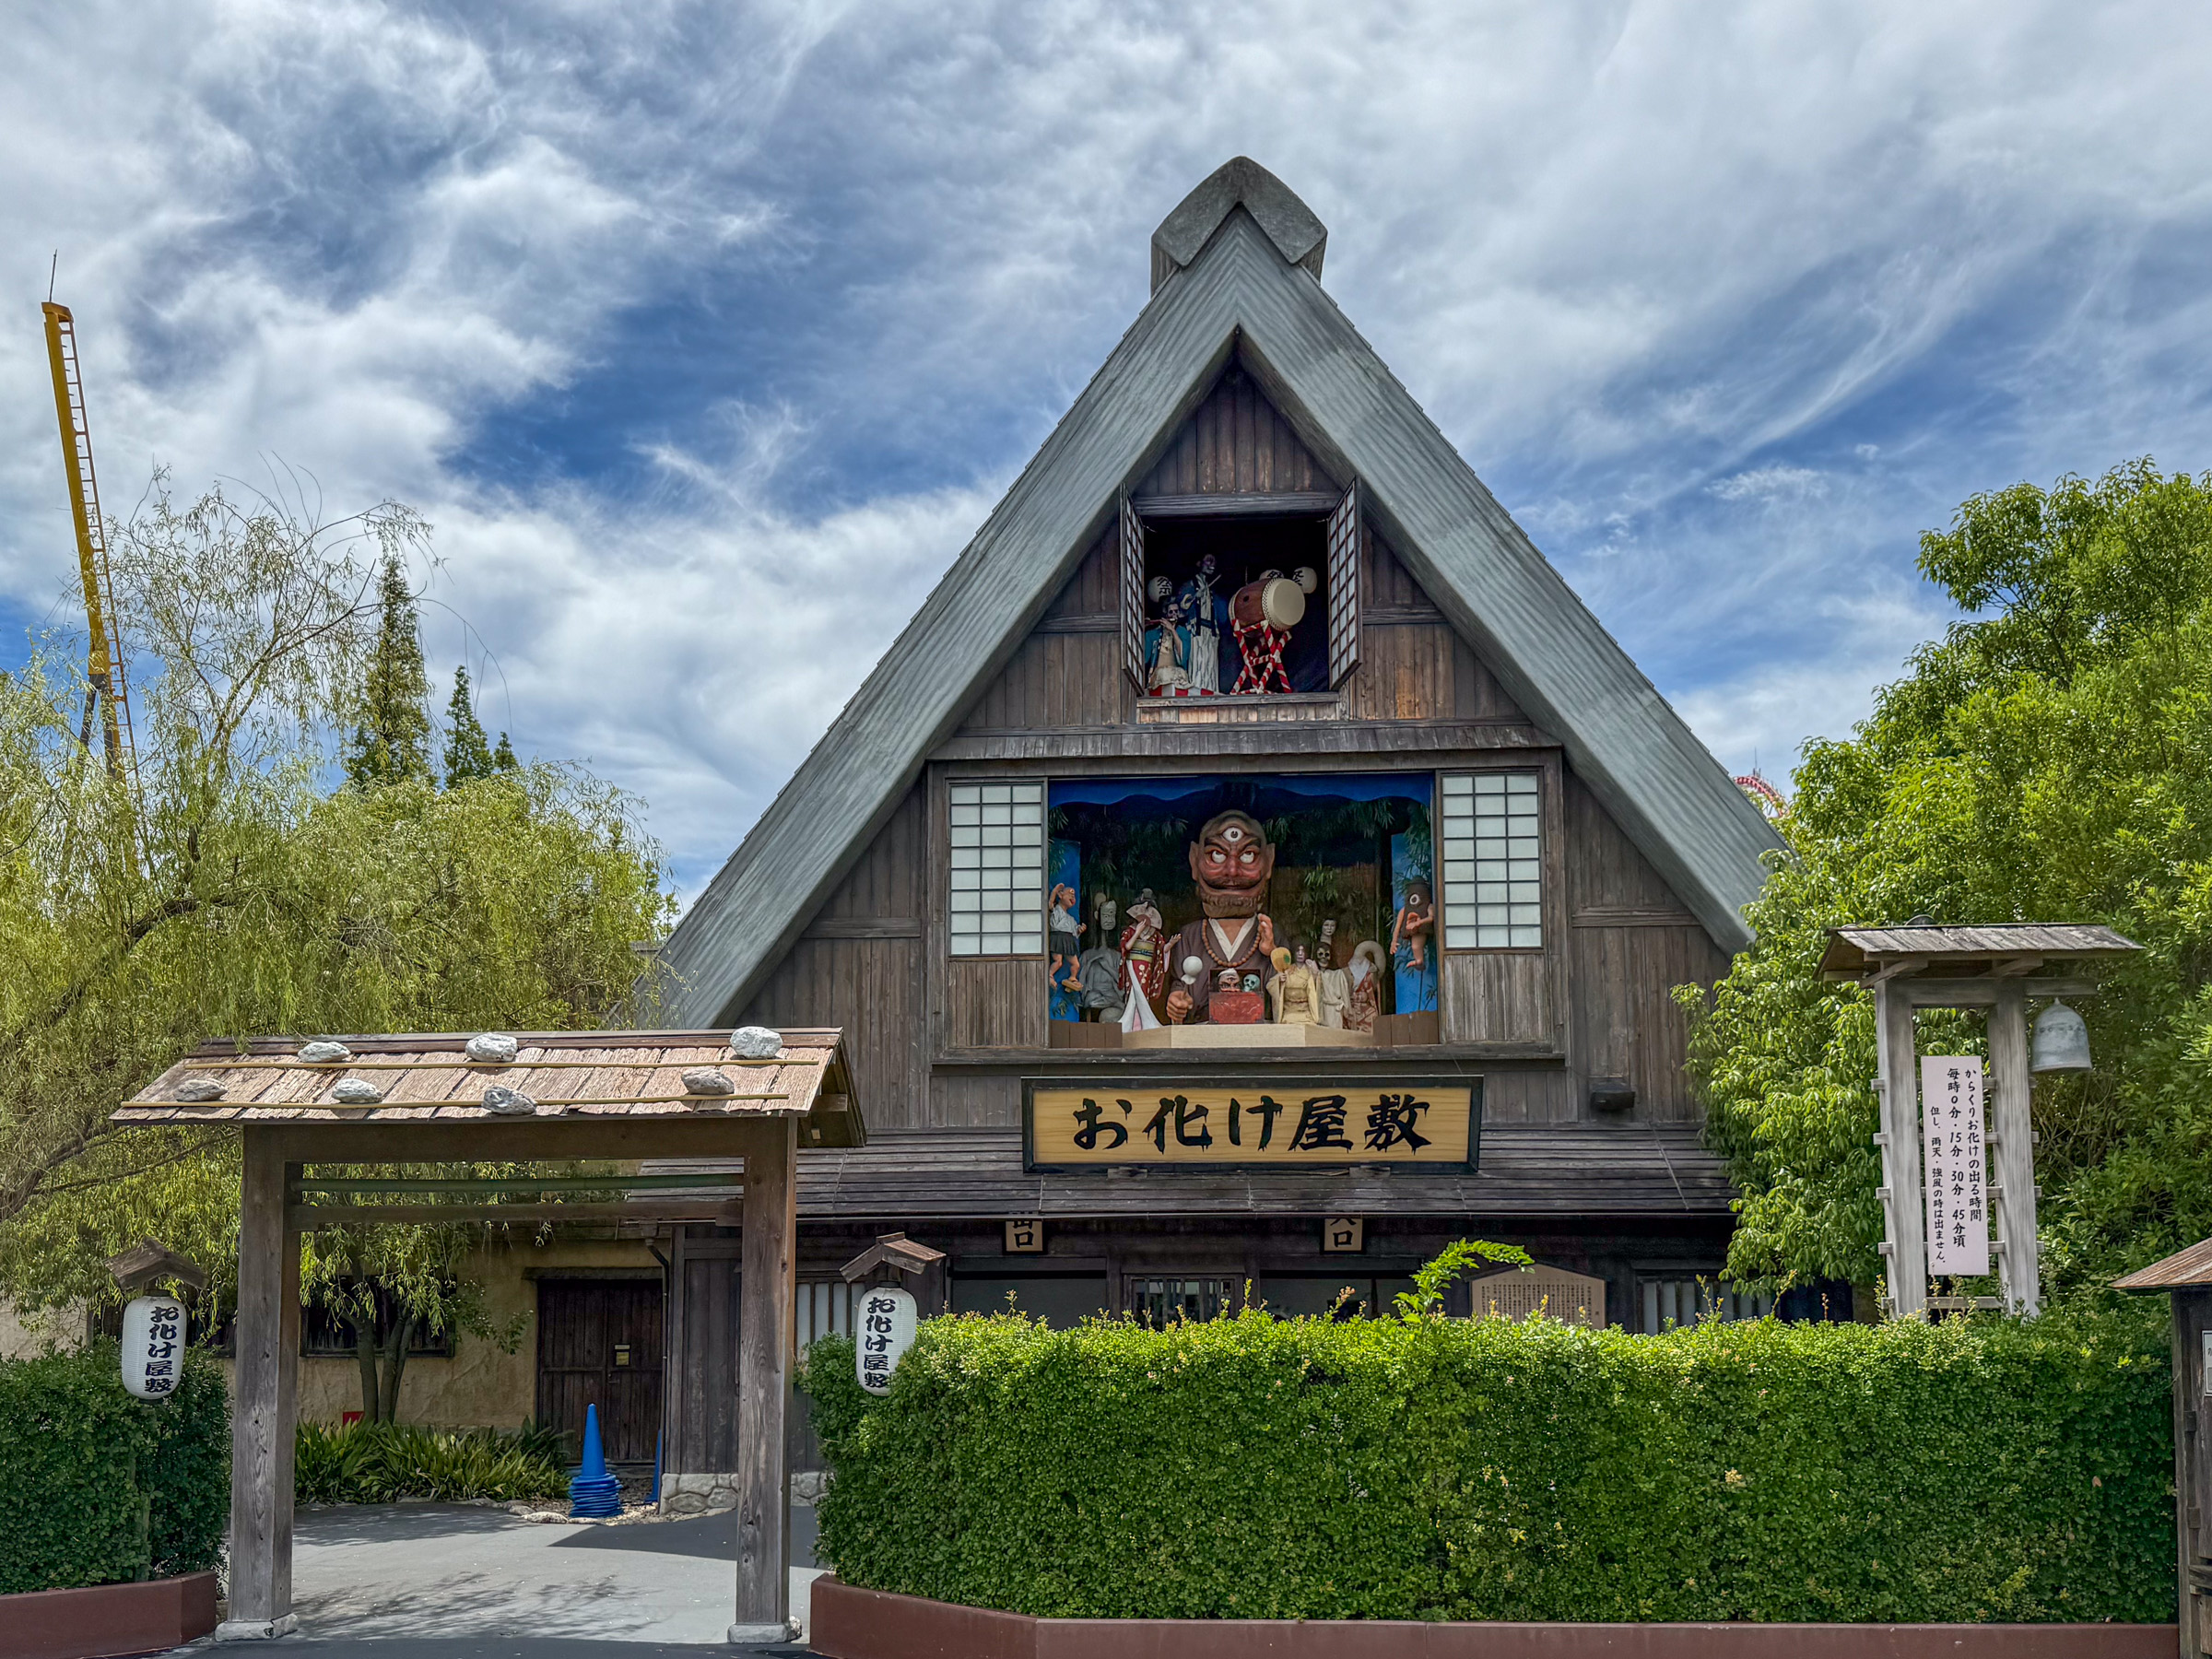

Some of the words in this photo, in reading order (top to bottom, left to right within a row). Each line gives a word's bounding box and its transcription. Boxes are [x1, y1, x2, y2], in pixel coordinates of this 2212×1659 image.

[1072, 1094, 1432, 1155] お化け屋敷
[1965, 1068, 1983, 1222] からくりお化けの出る時間
[145, 1306, 180, 1393] お化け屋敷
[864, 1297, 897, 1388] お化け屋敷
